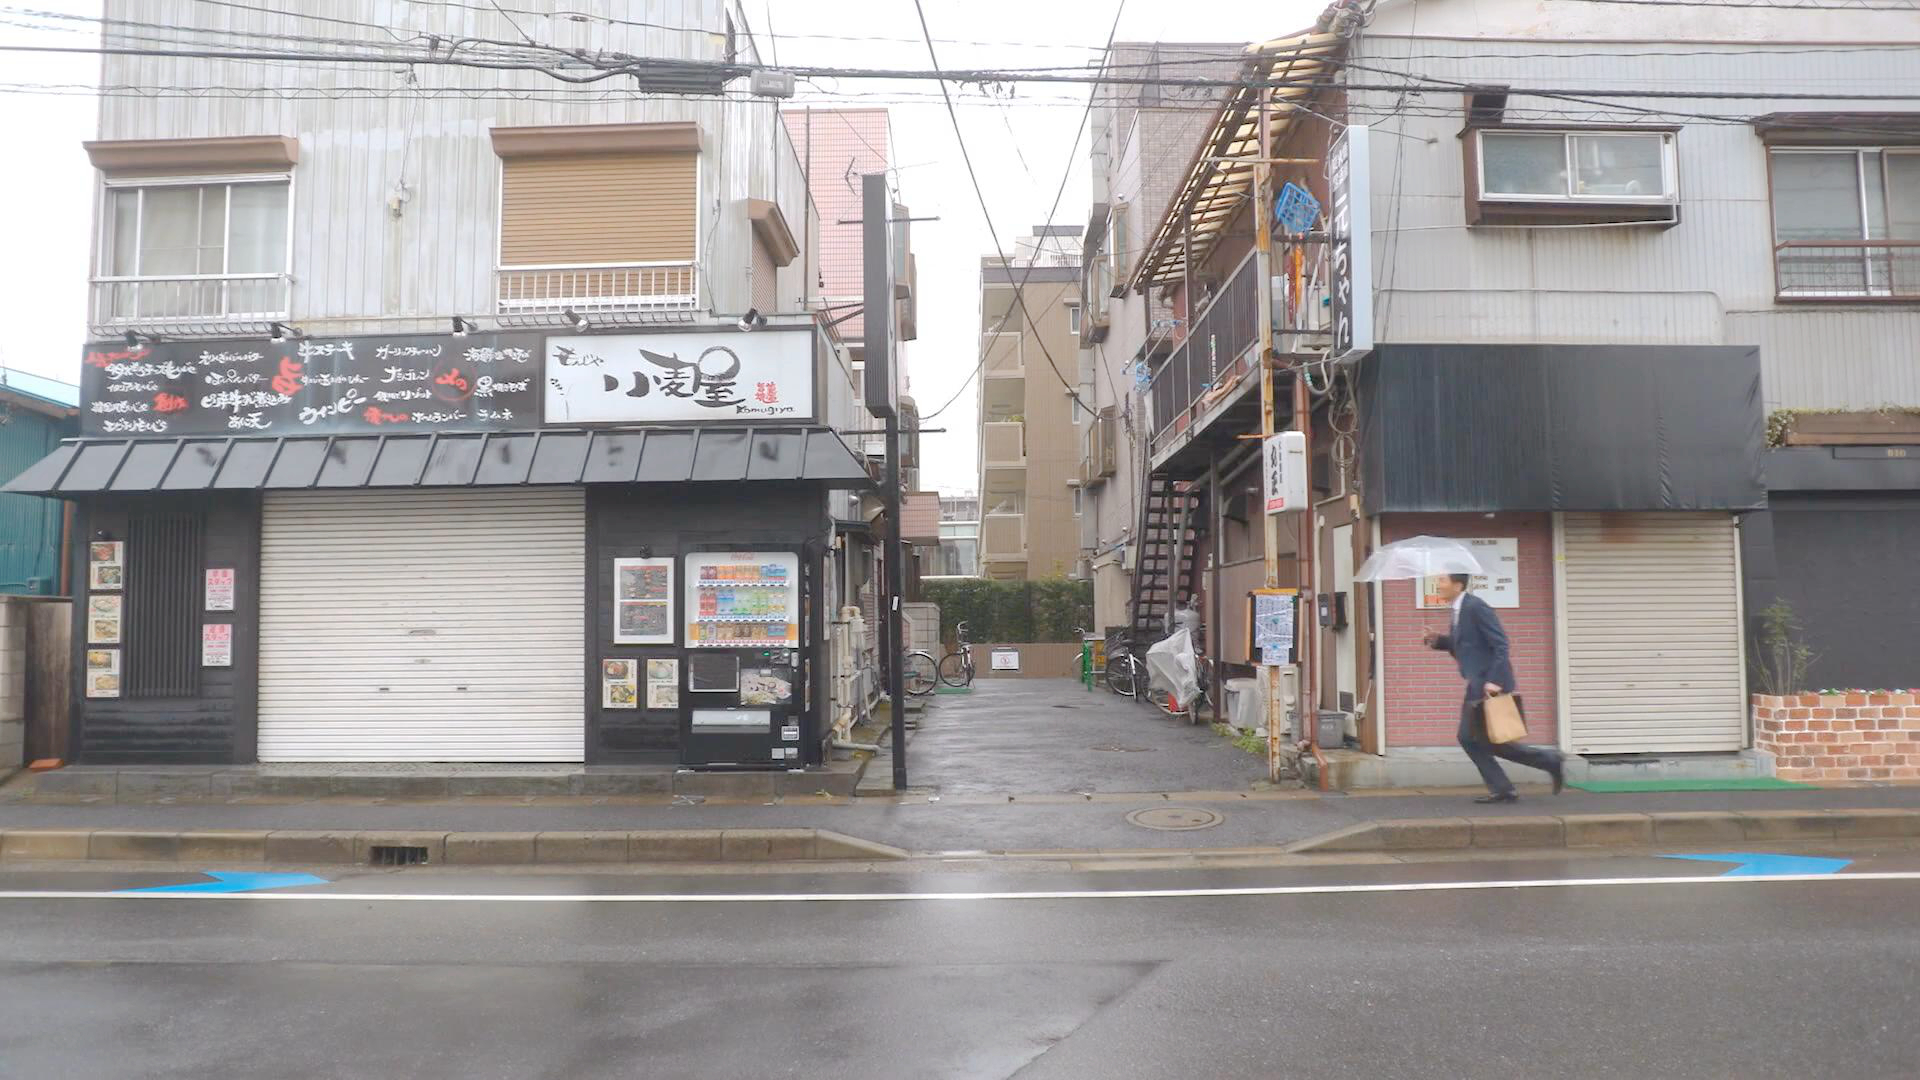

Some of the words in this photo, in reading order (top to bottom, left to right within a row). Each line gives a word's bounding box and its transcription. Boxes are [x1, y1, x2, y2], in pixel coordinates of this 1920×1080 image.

[604, 345, 746, 408] 小麦屋
[412, 410, 468, 424] ホームランバー
[477, 408, 513, 422] ラムネ
[736, 404, 796, 416] Komugiya
